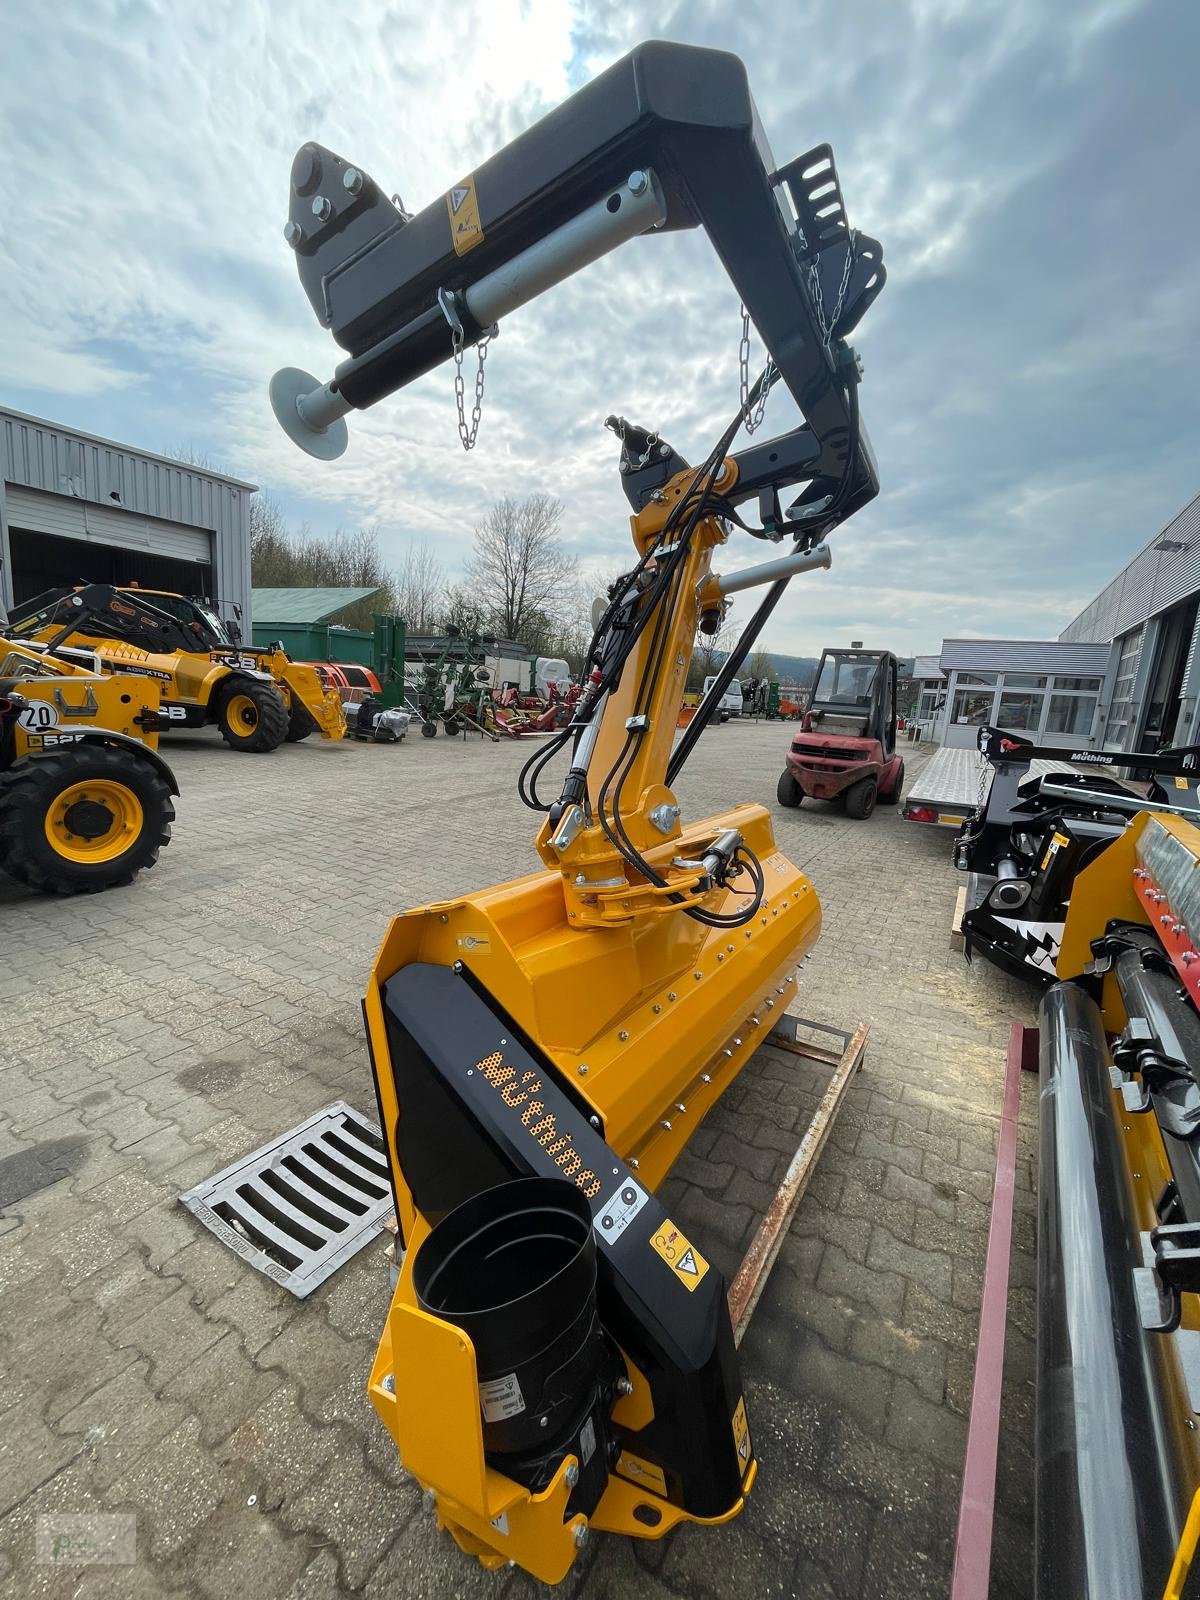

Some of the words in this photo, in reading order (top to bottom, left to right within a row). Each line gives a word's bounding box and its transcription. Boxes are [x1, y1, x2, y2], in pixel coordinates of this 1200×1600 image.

[212, 656, 257, 670] JCB
[26, 706, 51, 727] 20
[1071, 751, 1114, 764] Müthing
